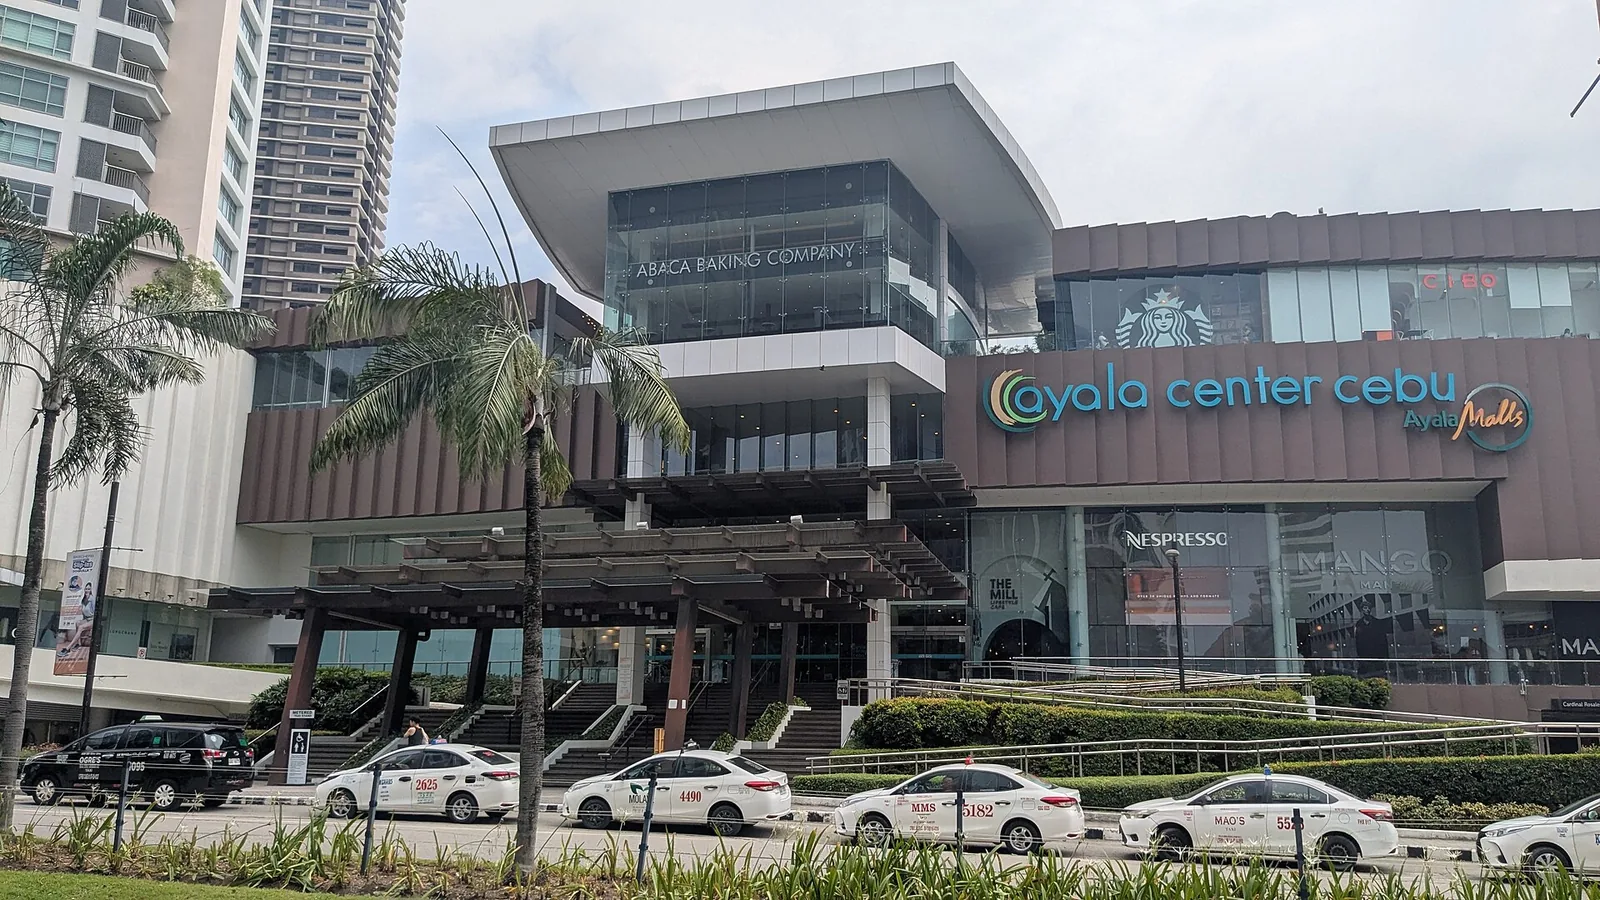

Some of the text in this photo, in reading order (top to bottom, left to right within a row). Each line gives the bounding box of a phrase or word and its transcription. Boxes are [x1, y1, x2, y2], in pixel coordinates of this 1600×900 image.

[636, 243, 855, 278] ABACA BAKING COMPANY
[1423, 273, 1497, 289] CIBO
[1014, 362, 1455, 421] ayala center cebu
[1403, 399, 1523, 441] Ayala Malls
[1126, 530, 1228, 550] NESPRESSO
[1297, 550, 1452, 576] MANGO
[990, 578, 1012, 589] THE
[990, 589, 1018, 600] MILL
[415, 779, 438, 790] 2625
[629, 794, 649, 804] MOLA
[679, 790, 702, 802] 4490
[911, 803, 936, 812] MMS
[962, 803, 994, 817] 5182
[1214, 816, 1246, 825] MAO'S
